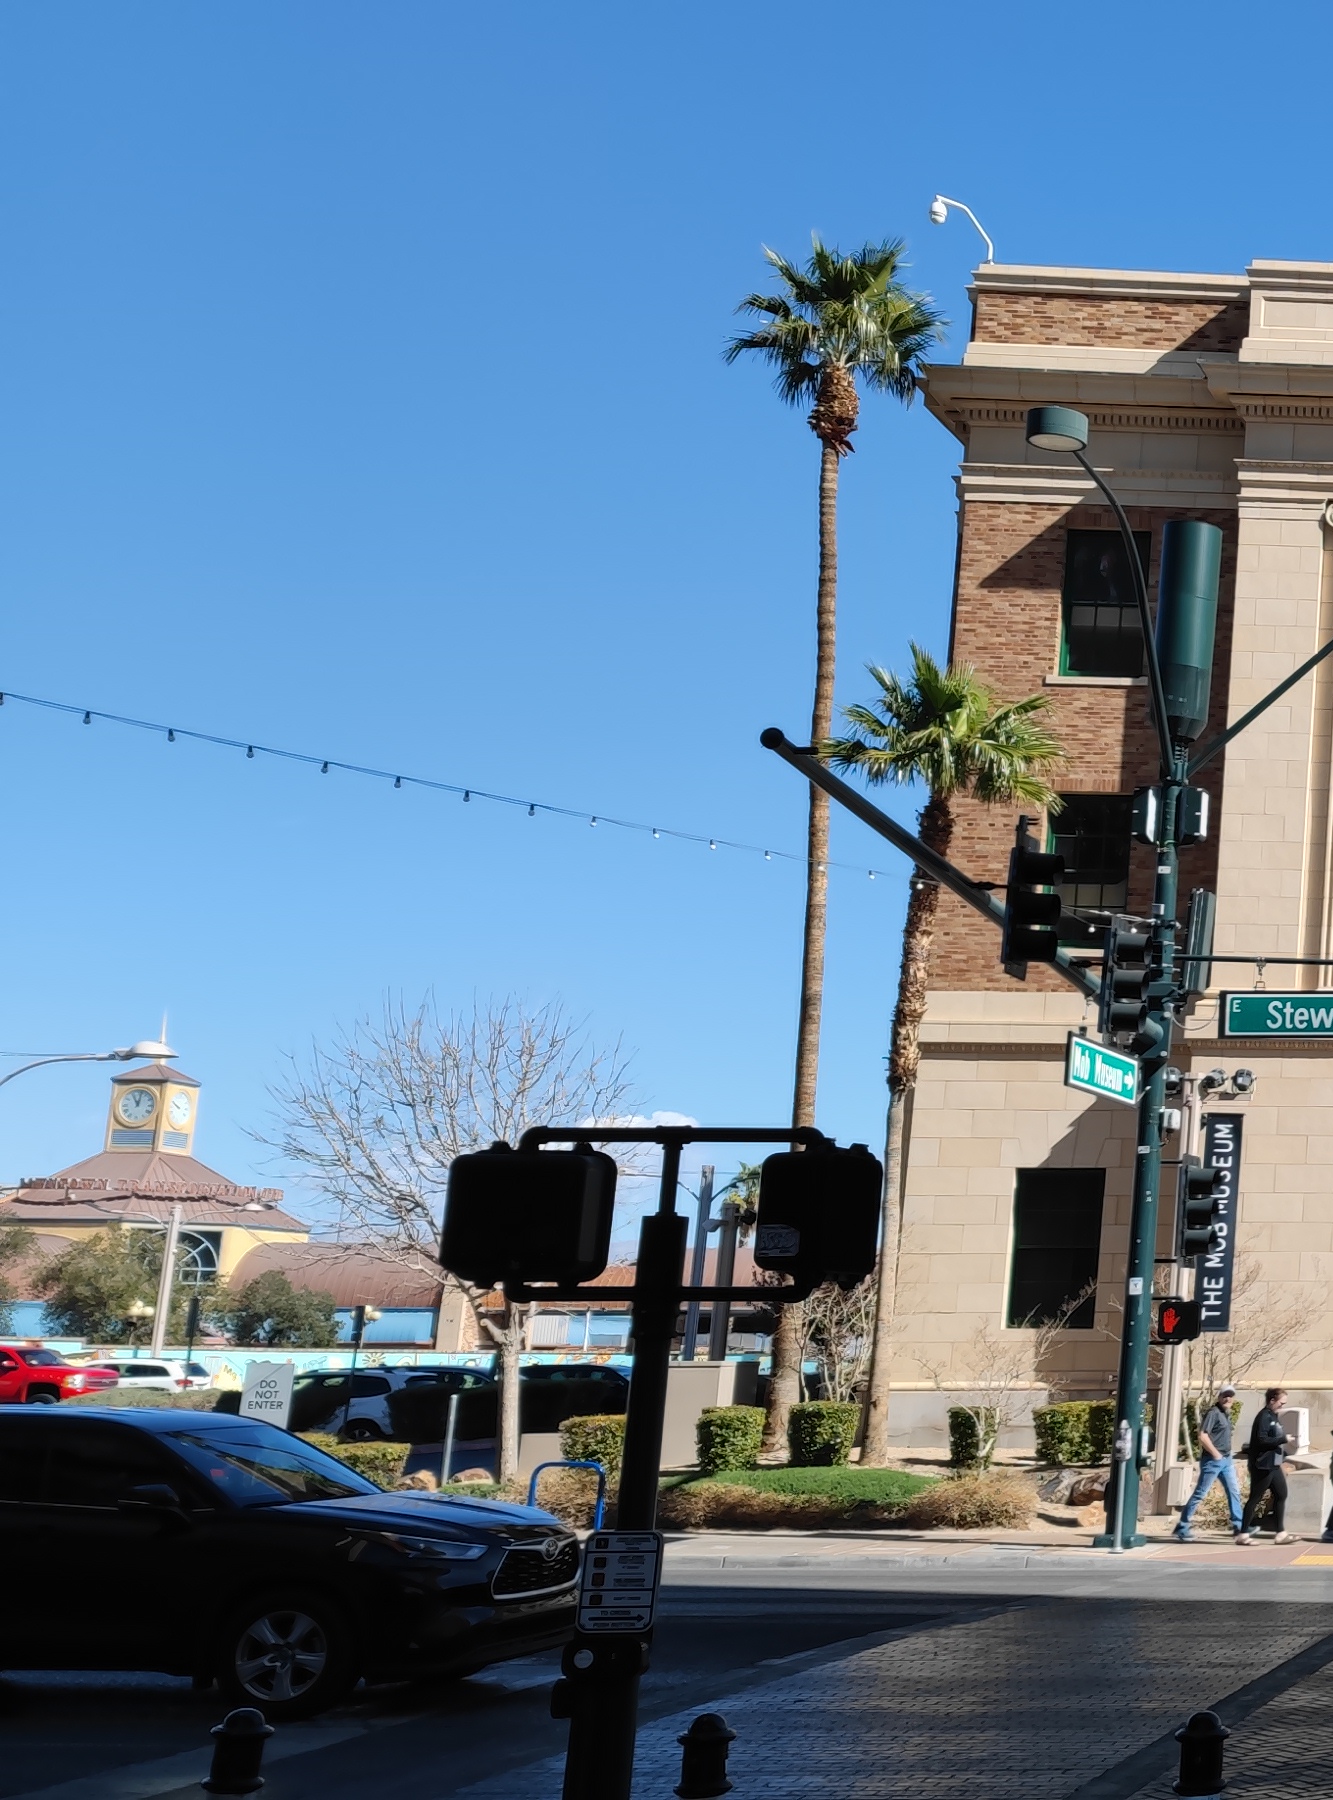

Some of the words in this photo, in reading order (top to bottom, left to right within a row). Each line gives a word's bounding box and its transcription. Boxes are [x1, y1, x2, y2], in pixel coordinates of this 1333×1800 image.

[1232, 1000, 1242, 1013] E
[1073, 1044, 1091, 1081] Mob
[1094, 1052, 1124, 1093] Museum
[1201, 1275, 1225, 1321] THE
[260, 1379, 278, 1389] DO
[254, 1390, 279, 1400] NOT
[247, 1400, 284, 1410] ENTER
